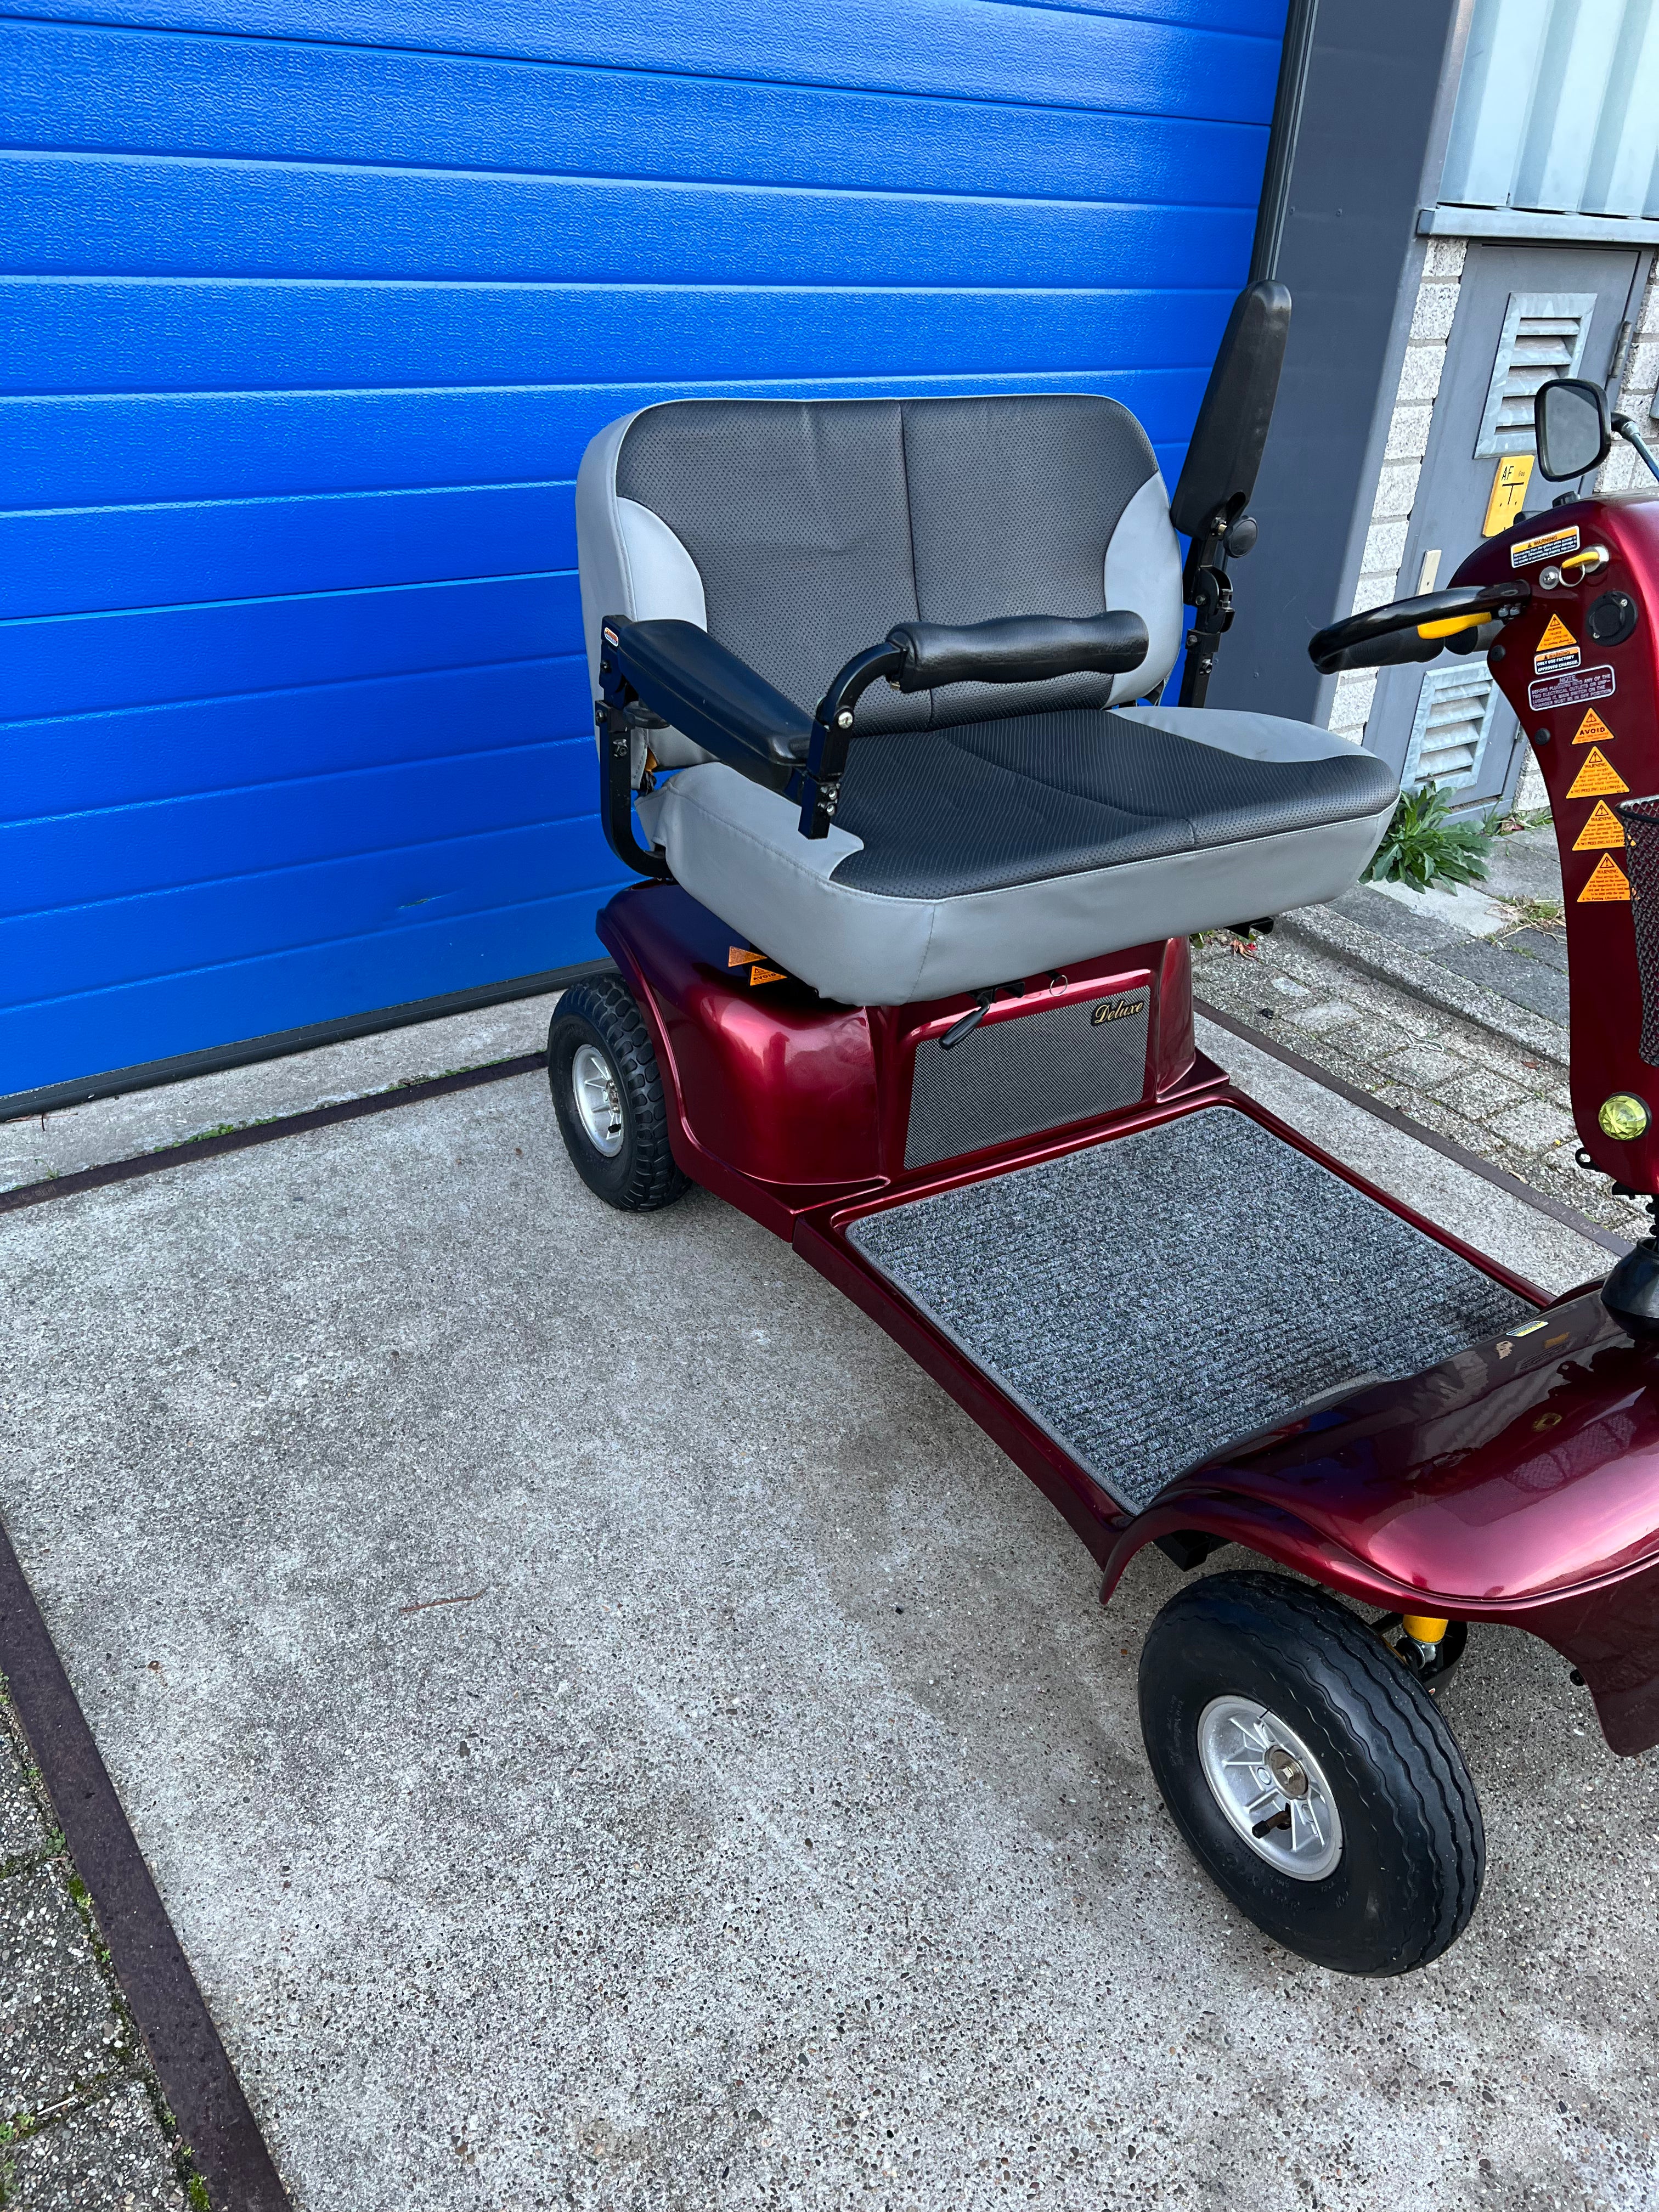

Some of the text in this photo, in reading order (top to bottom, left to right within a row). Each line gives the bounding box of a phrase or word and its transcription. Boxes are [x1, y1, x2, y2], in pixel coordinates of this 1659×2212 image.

[1501, 466, 1514, 481] AF
[1534, 535, 1557, 544] WARNING
[1094, 1001, 1143, 1024] Deluxe
